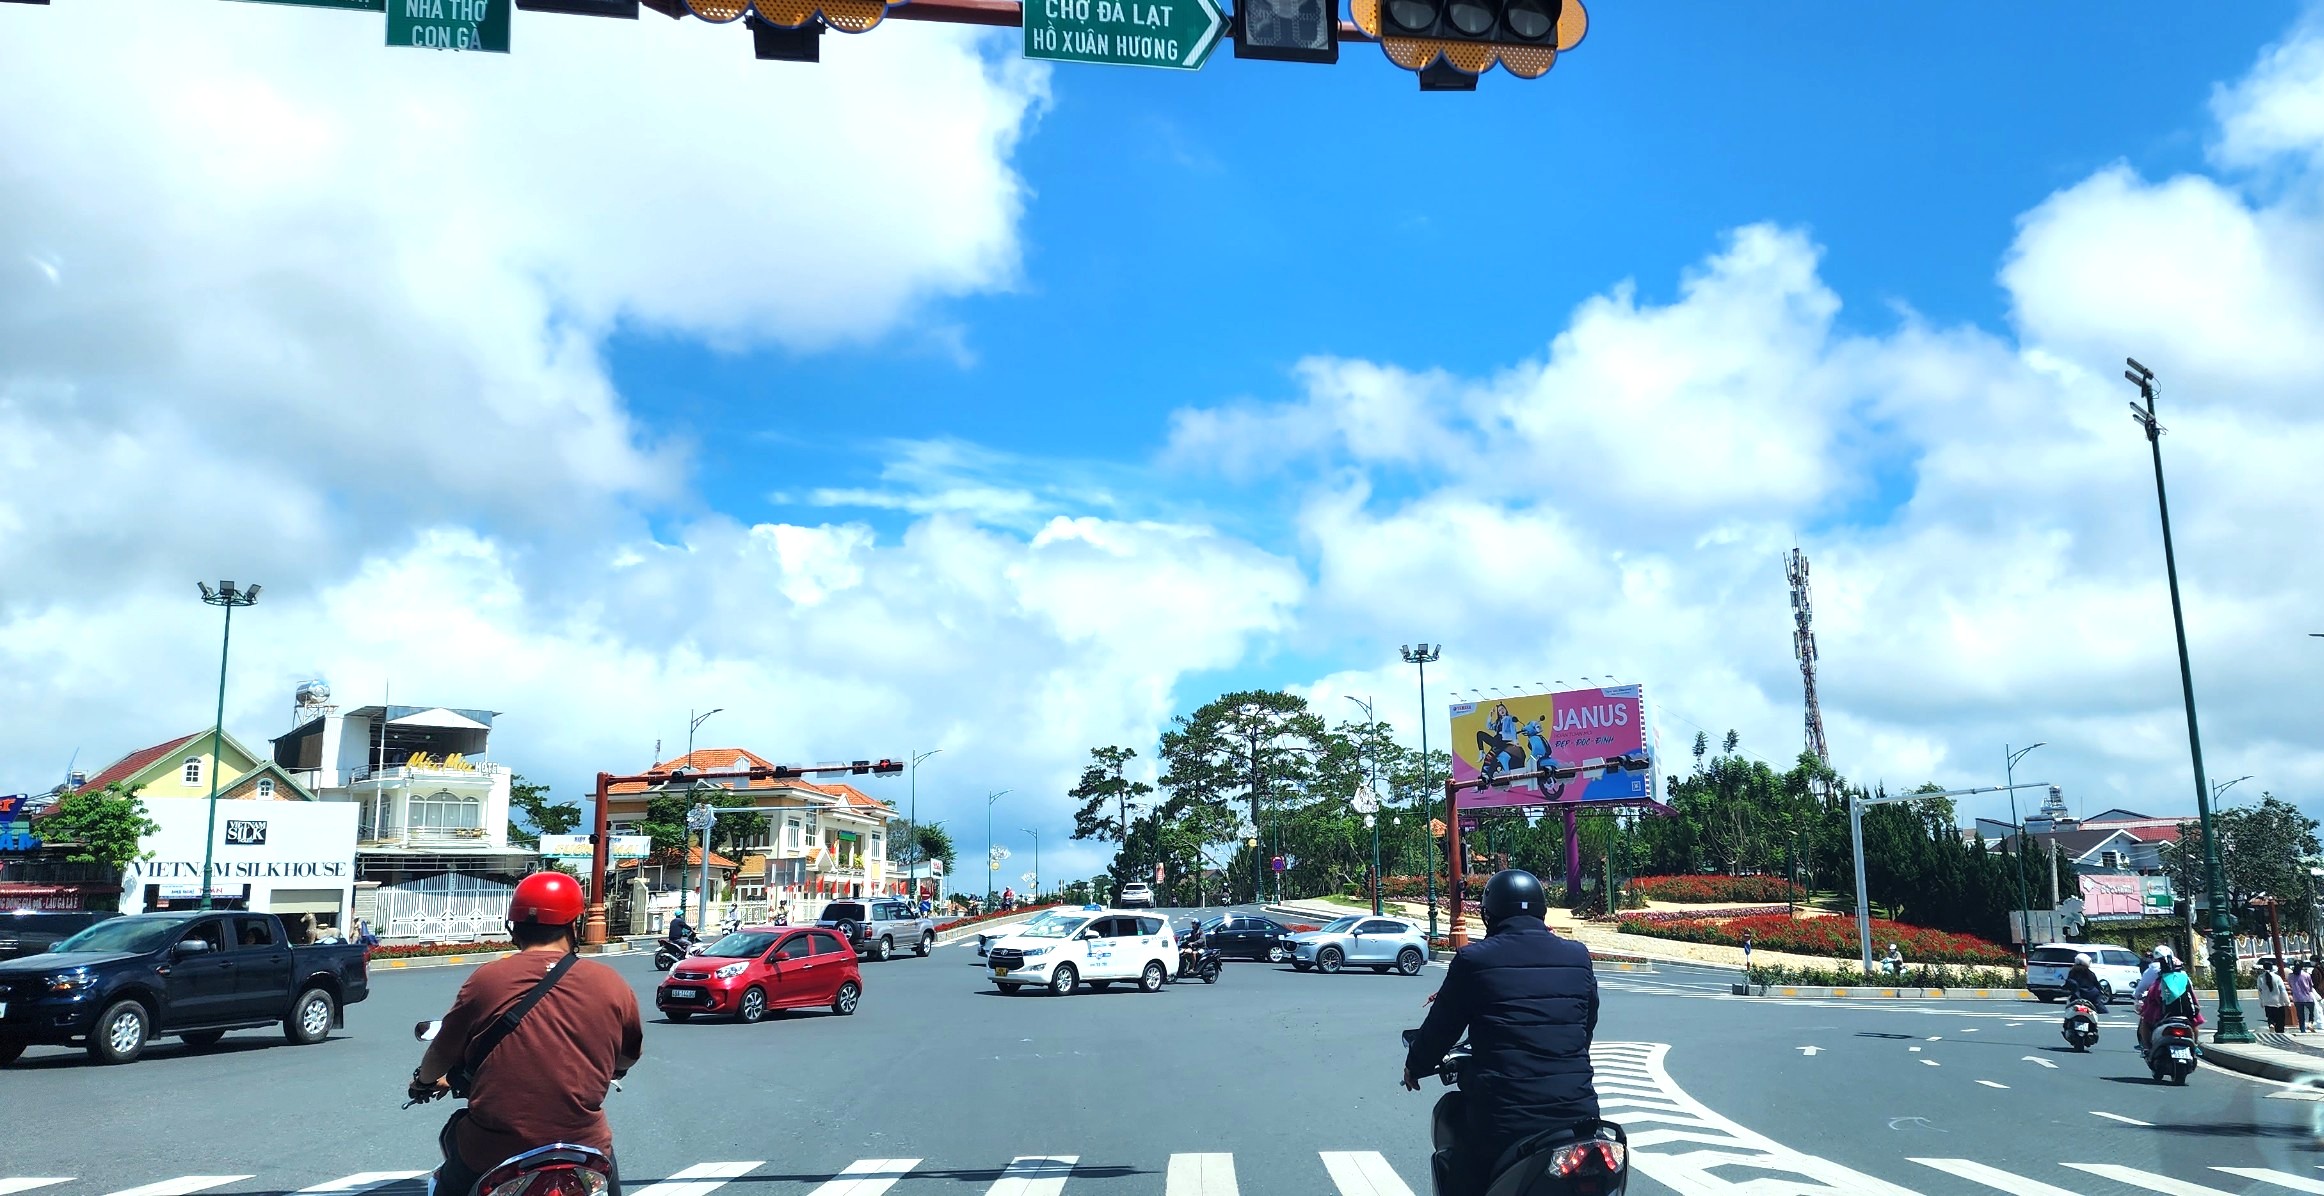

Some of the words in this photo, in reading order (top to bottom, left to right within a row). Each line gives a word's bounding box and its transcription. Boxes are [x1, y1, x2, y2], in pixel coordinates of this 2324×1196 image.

[1046, 0, 1090, 24] CHỢ
[1133, 4, 1173, 29] LẠT
[412, 25, 450, 48] CON
[457, 22, 483, 49] GÀ
[1033, 20, 1057, 51] HỒ
[1062, 28, 1109, 56] XUÂN
[1116, 35, 1178, 61] HƯƠNG
[1552, 703, 1628, 731] JANUS
[475, 761, 501, 774] HOTEL
[228, 826, 265, 840] SILK
[235, 861, 285, 877] SILK
[285, 862, 346, 877] HOUSE
